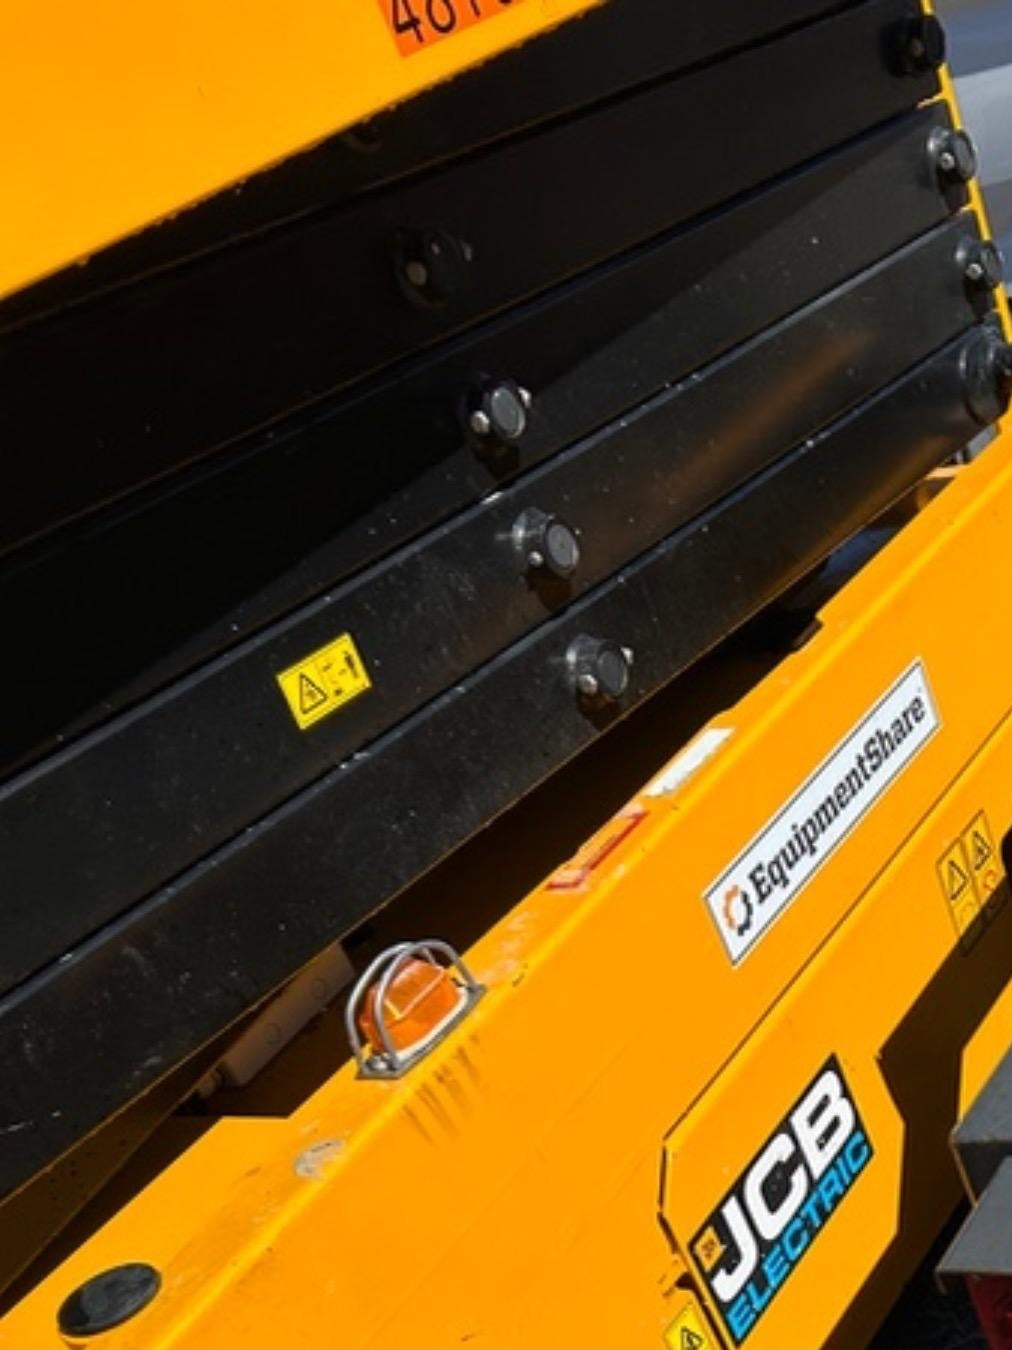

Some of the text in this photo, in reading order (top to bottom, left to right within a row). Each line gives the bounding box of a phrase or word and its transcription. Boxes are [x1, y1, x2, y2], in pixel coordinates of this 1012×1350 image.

[747, 696, 926, 905] EquipmentShare
[710, 1069, 856, 1303] JCB
[726, 1129, 869, 1342] ELECTRIC
